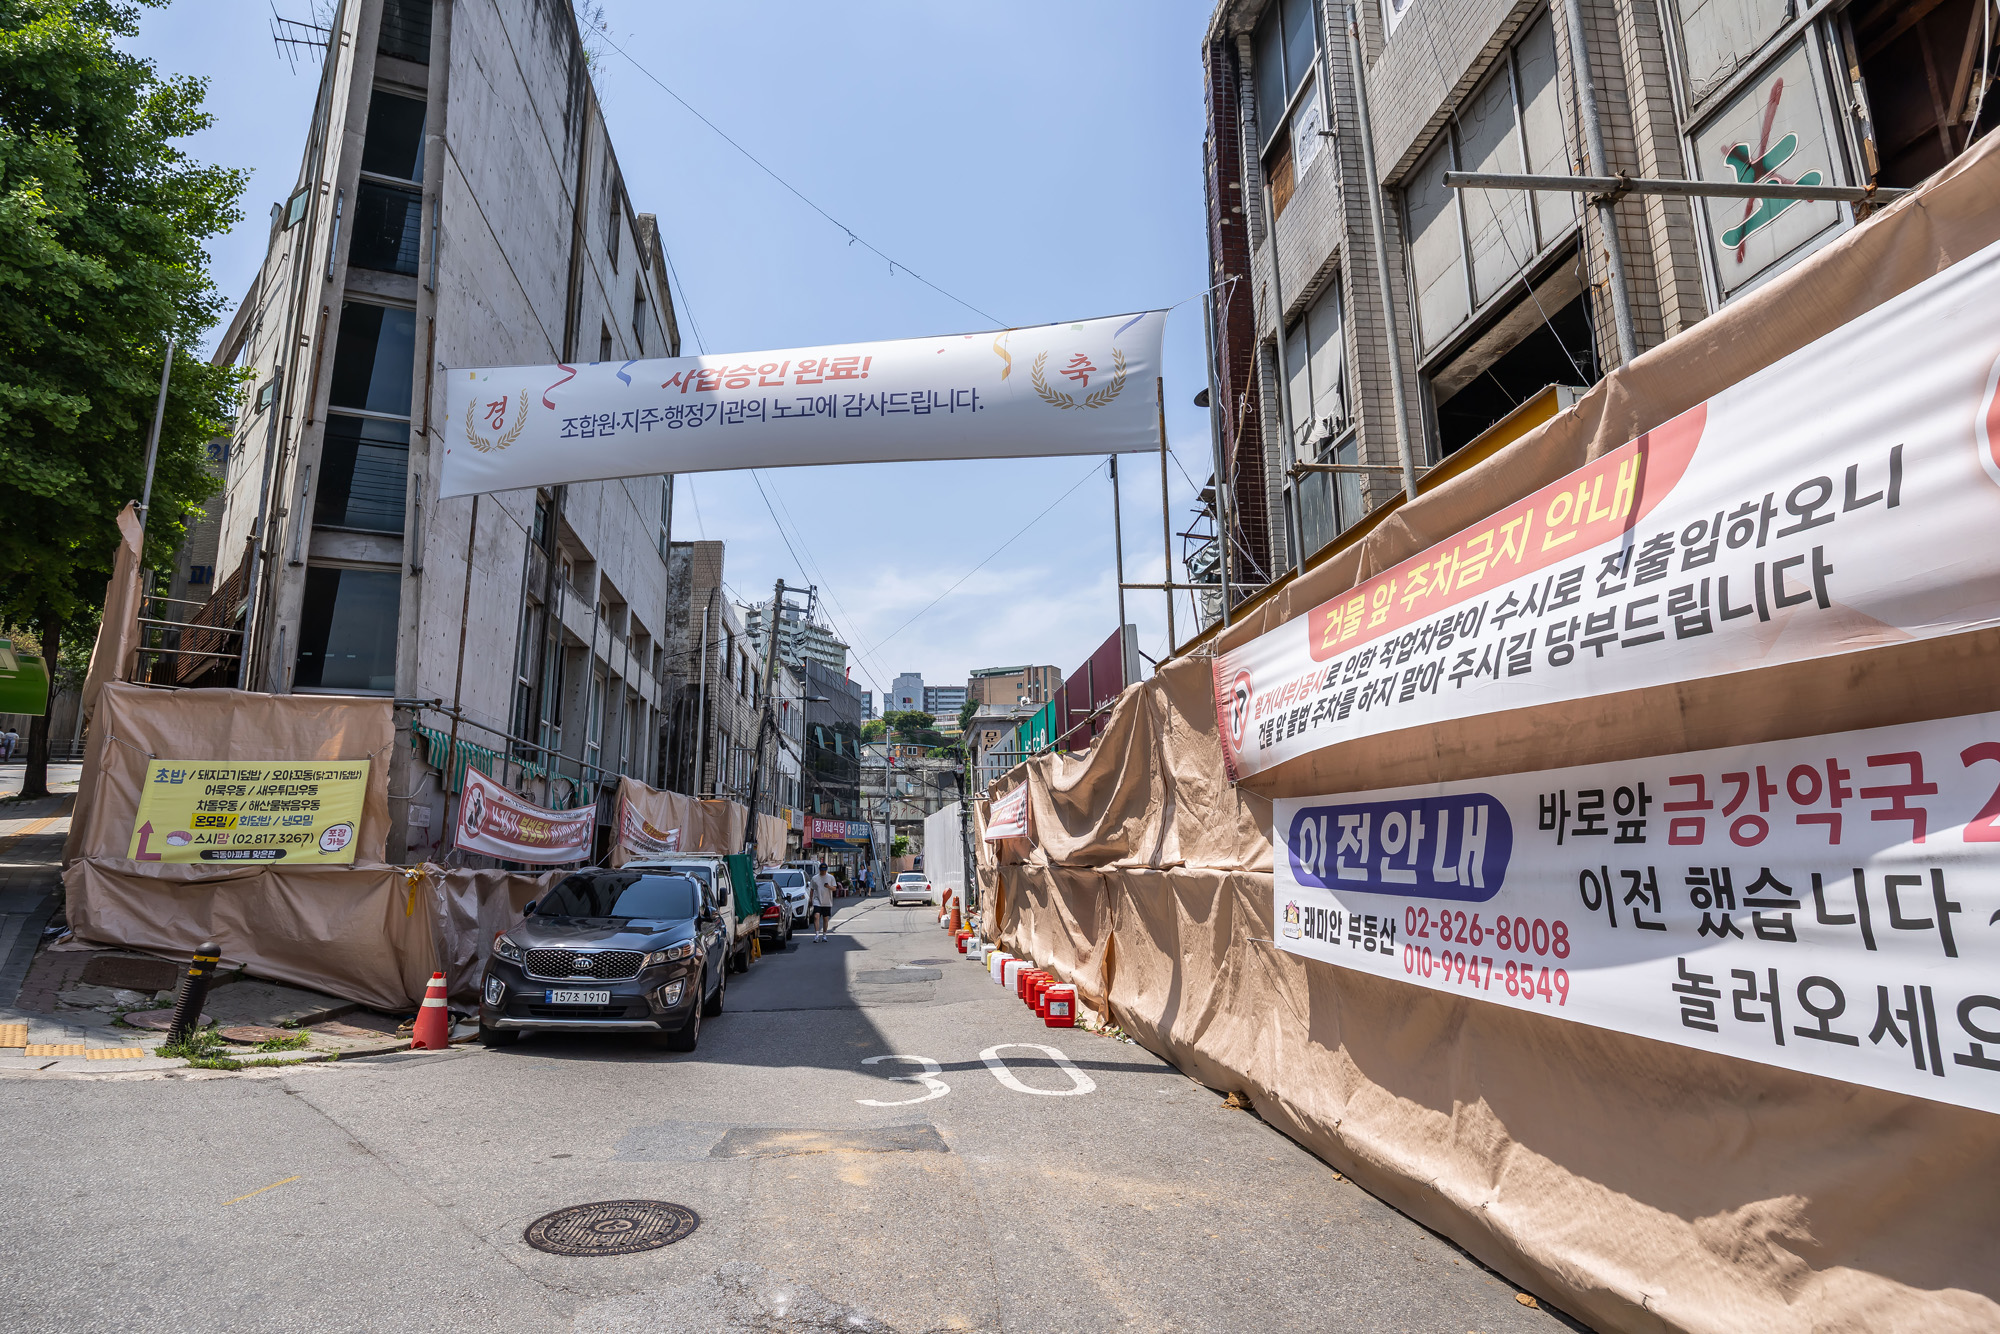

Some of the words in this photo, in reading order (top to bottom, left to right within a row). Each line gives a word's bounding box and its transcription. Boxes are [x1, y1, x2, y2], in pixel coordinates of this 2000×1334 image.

[661, 360, 789, 394] 사업승인
[793, 356, 873, 385] 완료!
[1060, 353, 1097, 388] 축
[484, 396, 508, 430] 경
[771, 395, 837, 419] 노고에
[842, 388, 984, 418] 감사드립니다.
[1321, 593, 1366, 651] 건물
[1367, 581, 1398, 630] 앞
[1400, 508, 1534, 612] 주차금지
[1541, 451, 1643, 551] 안내
[1341, 642, 1378, 684] 인한
[1378, 601, 1488, 667] 작업차량이
[1490, 565, 1586, 631] 수시로
[1595, 443, 1904, 597] 진출입하오니
[1258, 718, 1275, 751] 건물
[1275, 712, 1287, 743] 앞
[1286, 702, 1313, 739] 불법
[1311, 688, 1358, 728] 주차를
[1357, 672, 1398, 712] 하지
[1398, 657, 1444, 703] 말아
[1448, 624, 1537, 689] 주시길
[1545, 545, 1834, 668] 당부드립니다
[154, 768, 187, 784] 초밥
[197, 769, 262, 781] 돼지고기덮밥
[205, 784, 246, 796] 어묵우동
[256, 784, 318, 796] 새우튀김우동
[196, 800, 238, 812] 차돌우동
[248, 800, 320, 812] 해산물볶음우동
[1538, 781, 1653, 846] 바로앞
[1663, 751, 1938, 847] 금강약국
[194, 833, 229, 845] 스시맘
[232, 833, 315, 845] (02.817.3267)
[195, 815, 227, 828] 온모밀
[238, 815, 272, 827] 회덮밥
[282, 814, 313, 826] 냉모밀
[328, 828, 347, 837] 포장
[327, 838, 345, 846] 가능
[1300, 804, 1489, 889] 이전안내
[1579, 865, 1667, 931] 이전
[1684, 867, 1962, 958] 했습니다
[1304, 906, 1342, 945] 래미안
[1348, 913, 1396, 956] 부동산
[1405, 906, 1570, 959] 02-826-8008
[1404, 943, 1570, 1006] 010-9947-8549
[554, 992, 580, 1002] 157조
[584, 992, 608, 1003] 1910
[855, 1043, 1096, 1107] 30
